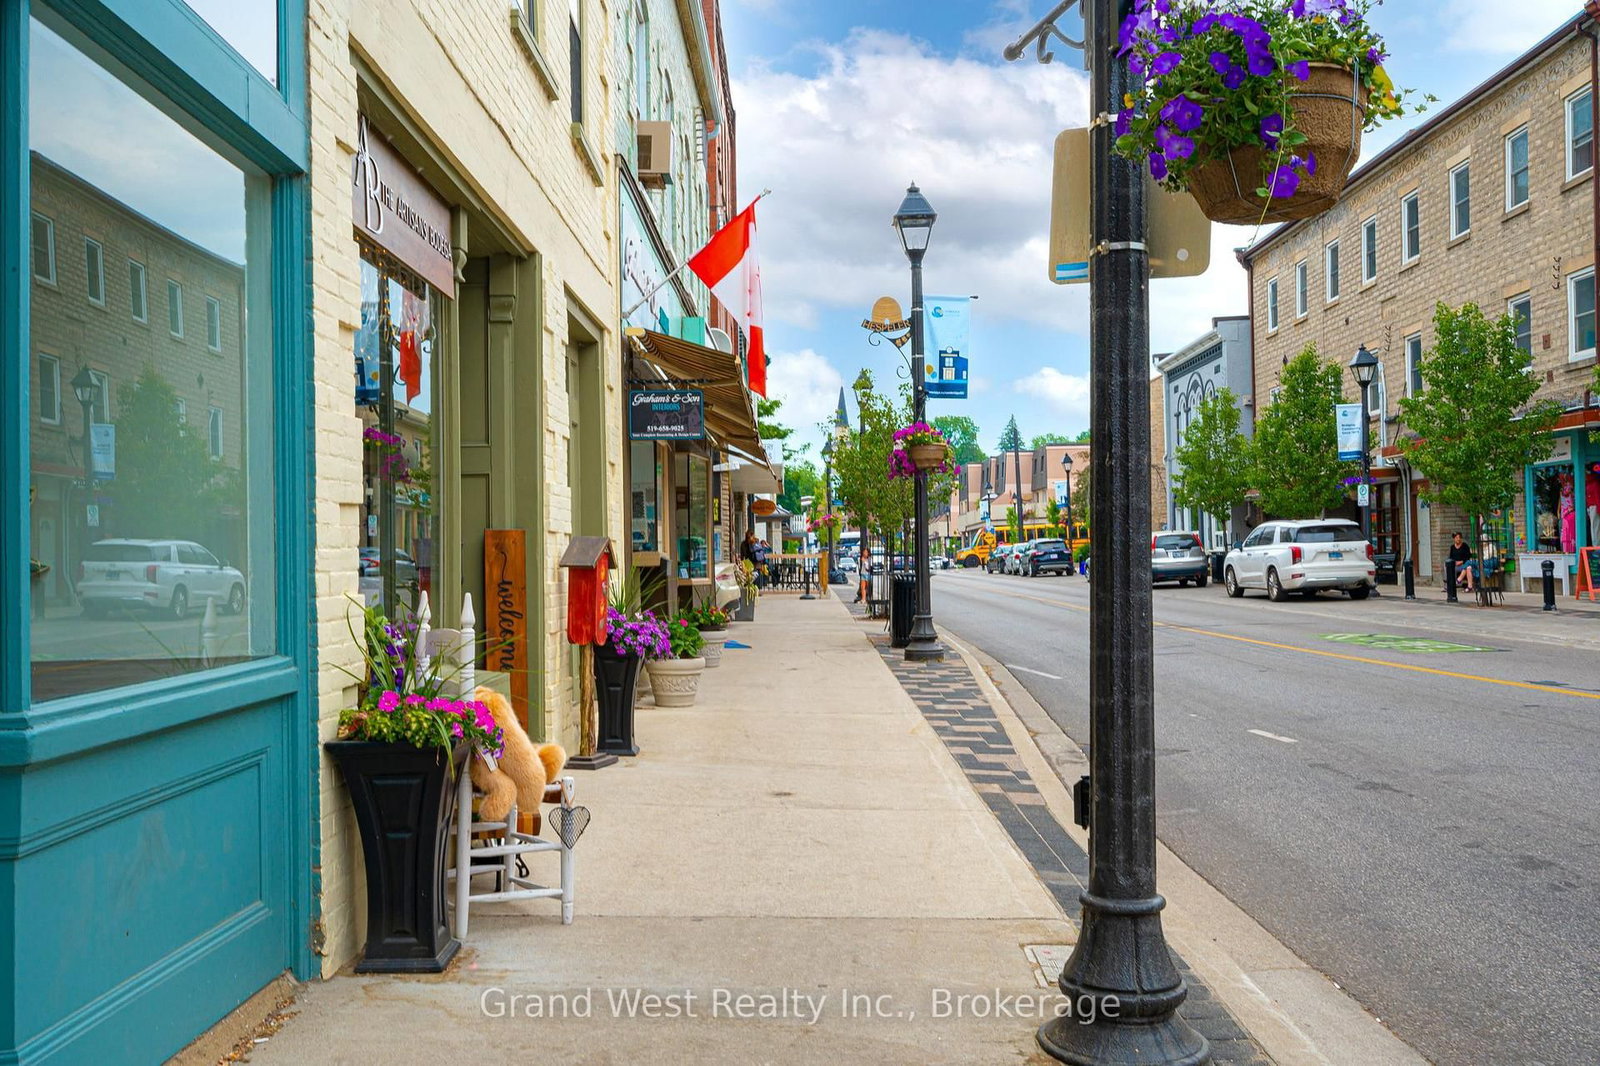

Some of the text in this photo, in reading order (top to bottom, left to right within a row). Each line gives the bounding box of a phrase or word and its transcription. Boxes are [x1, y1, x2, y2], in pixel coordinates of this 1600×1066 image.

[380, 181, 395, 212] THE
[396, 196, 427, 241] ARTISANS
[861, 319, 912, 332] HESPELER
[632, 392, 700, 406] Graham's & Son
[651, 403, 680, 411] INTERIORS
[497, 551, 523, 671] welcome
